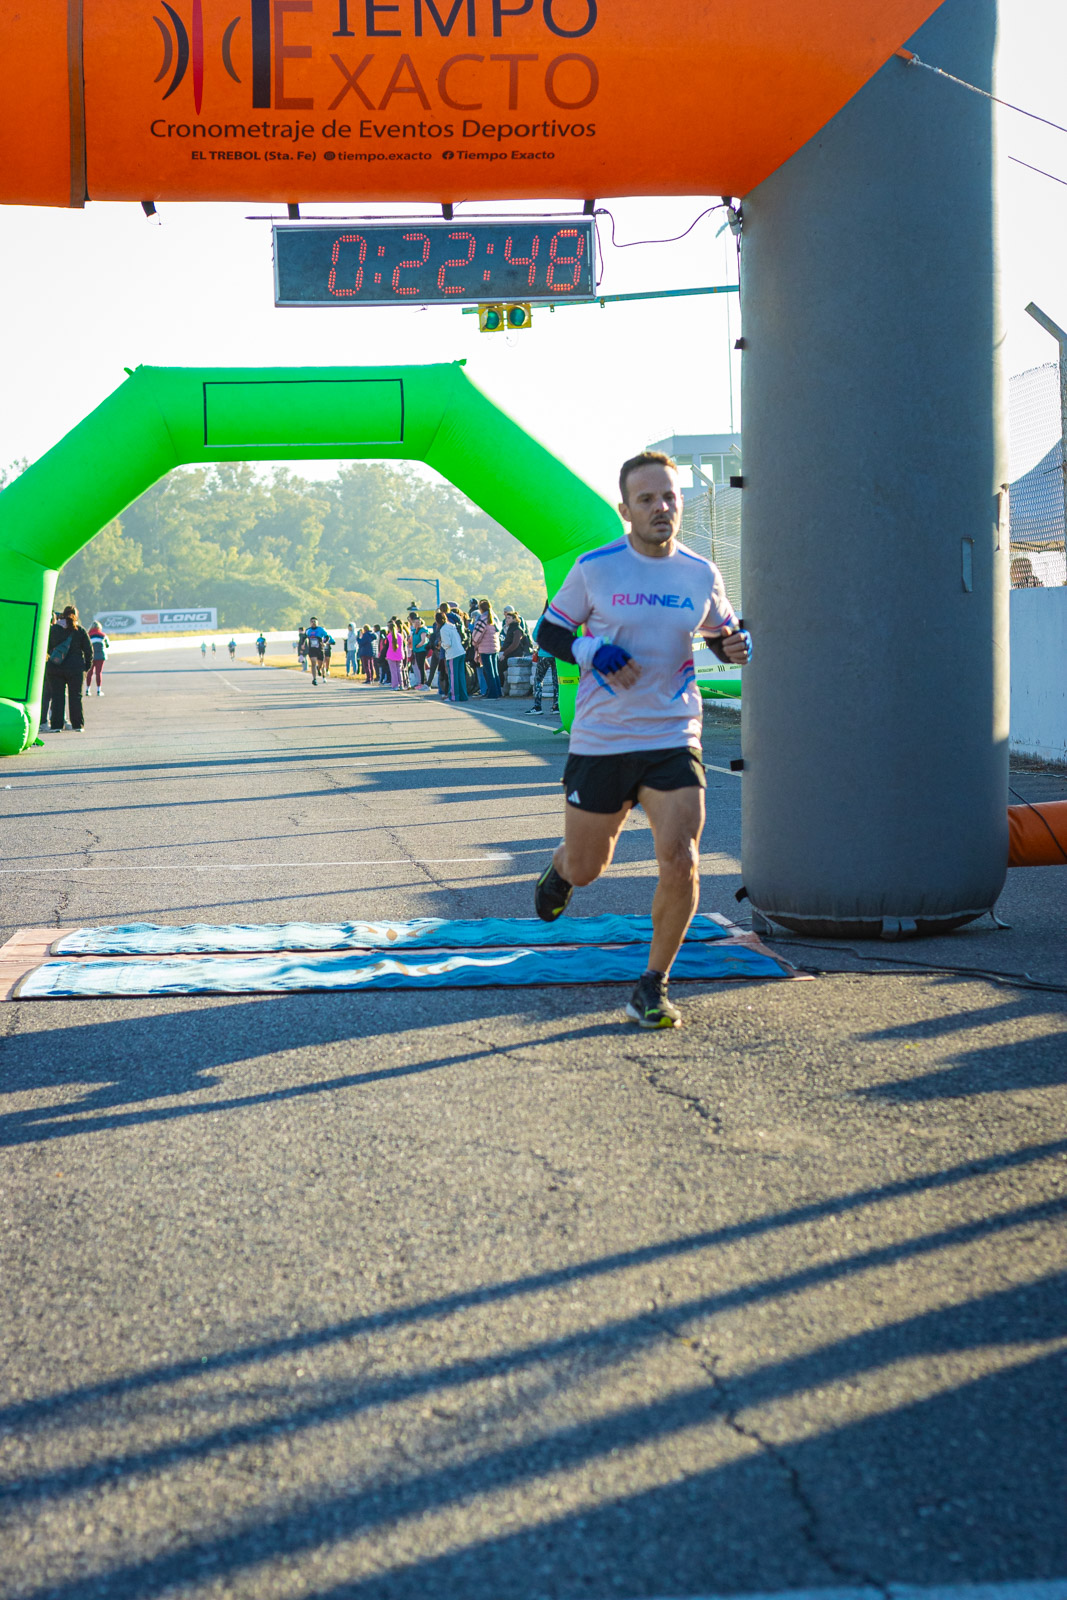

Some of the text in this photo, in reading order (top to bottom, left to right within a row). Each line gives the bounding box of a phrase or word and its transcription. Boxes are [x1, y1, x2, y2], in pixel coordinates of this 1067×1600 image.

[150, 119, 596, 142] Cronometraje de Eventos Deportivos
[191, 150, 555, 162] EL TREBOL (Sta. Fe) tiempo.exacto Tiempo Exacto
[328, 229, 585, 297] 0:22:48
[612, 593, 695, 611] RUNNEA
[104, 613, 208, 627] Ford LONG
